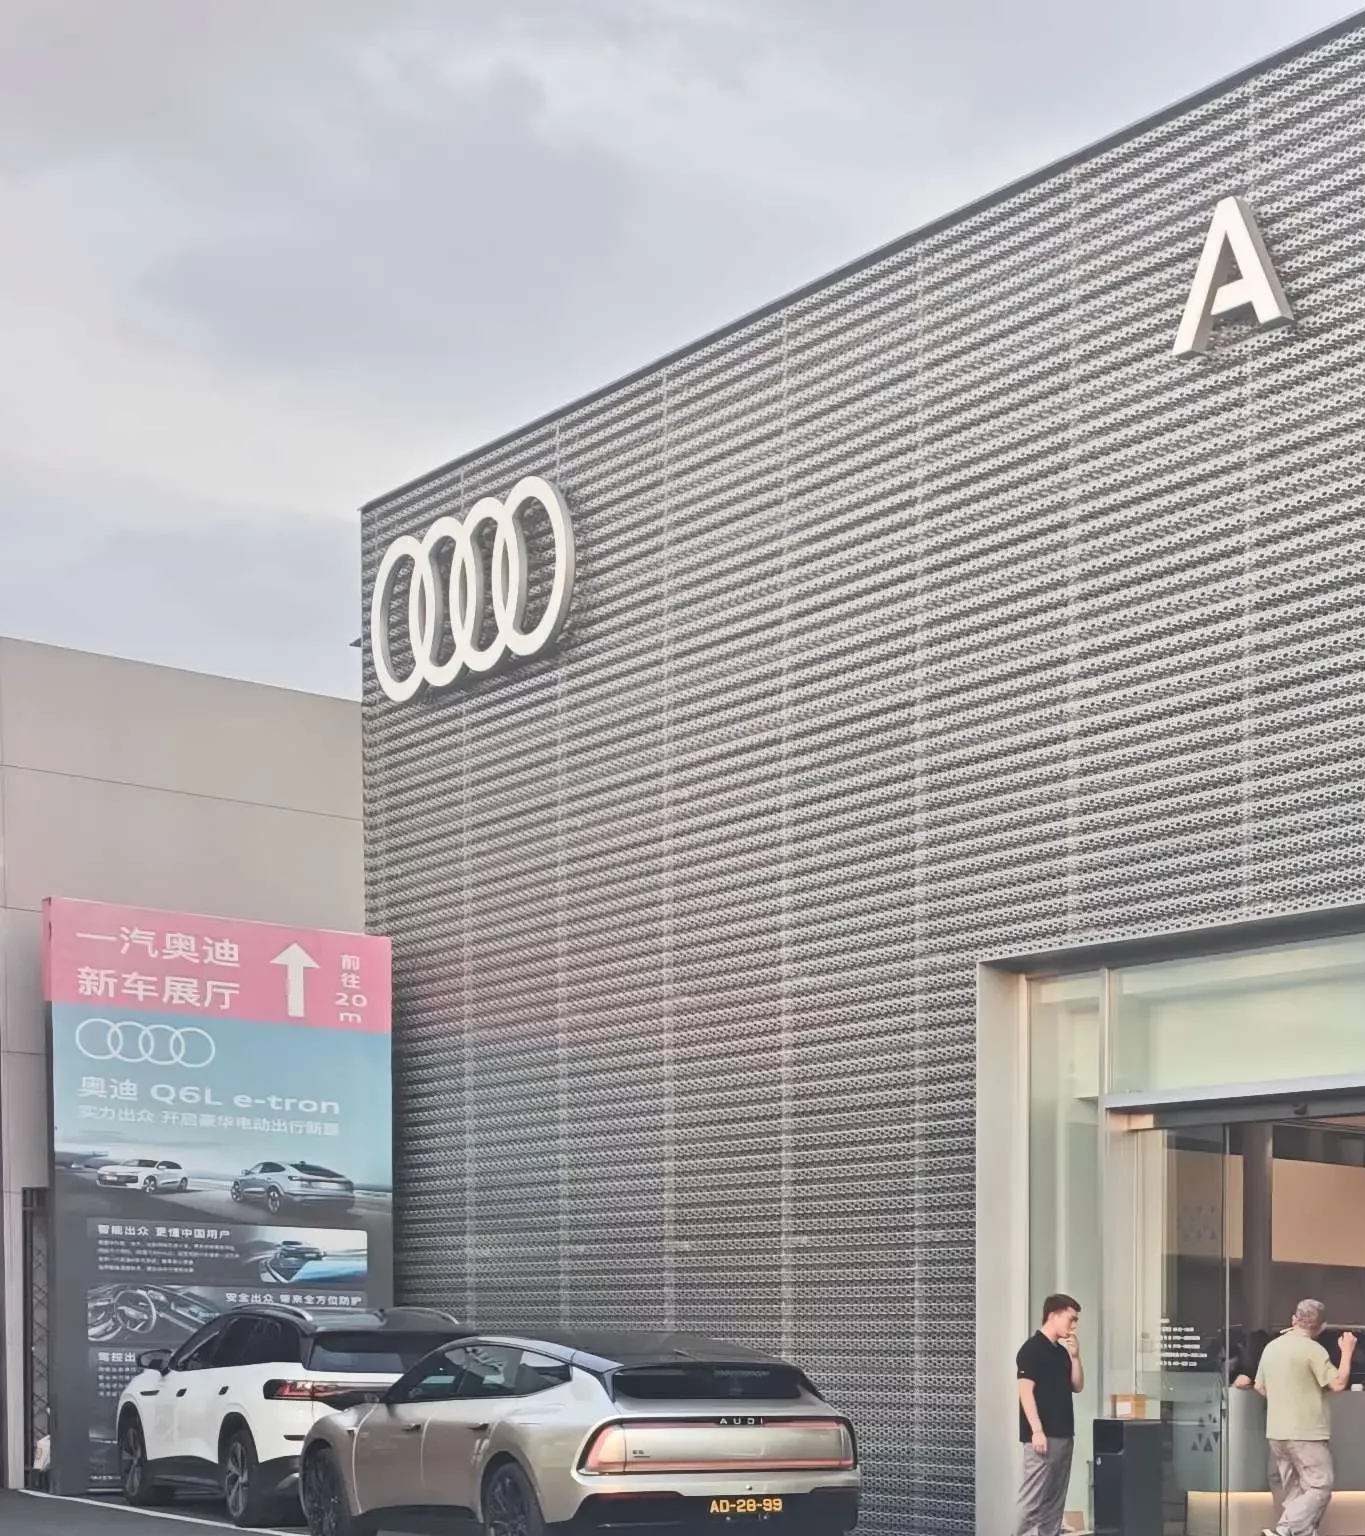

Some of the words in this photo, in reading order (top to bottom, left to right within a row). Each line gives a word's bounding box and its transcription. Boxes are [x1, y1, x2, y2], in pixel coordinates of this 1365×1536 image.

[76, 926, 241, 968] 一汽奥迪
[76, 966, 241, 1010] 新车展厅
[77, 1076, 139, 1101] 奥迪
[151, 1084, 223, 1106] Q6L
[233, 1093, 340, 1115] e-tron
[77, 1104, 156, 1124] 实力出众
[719, 1417, 764, 1425] AUDI
[709, 1498, 783, 1513] AD-28-99
